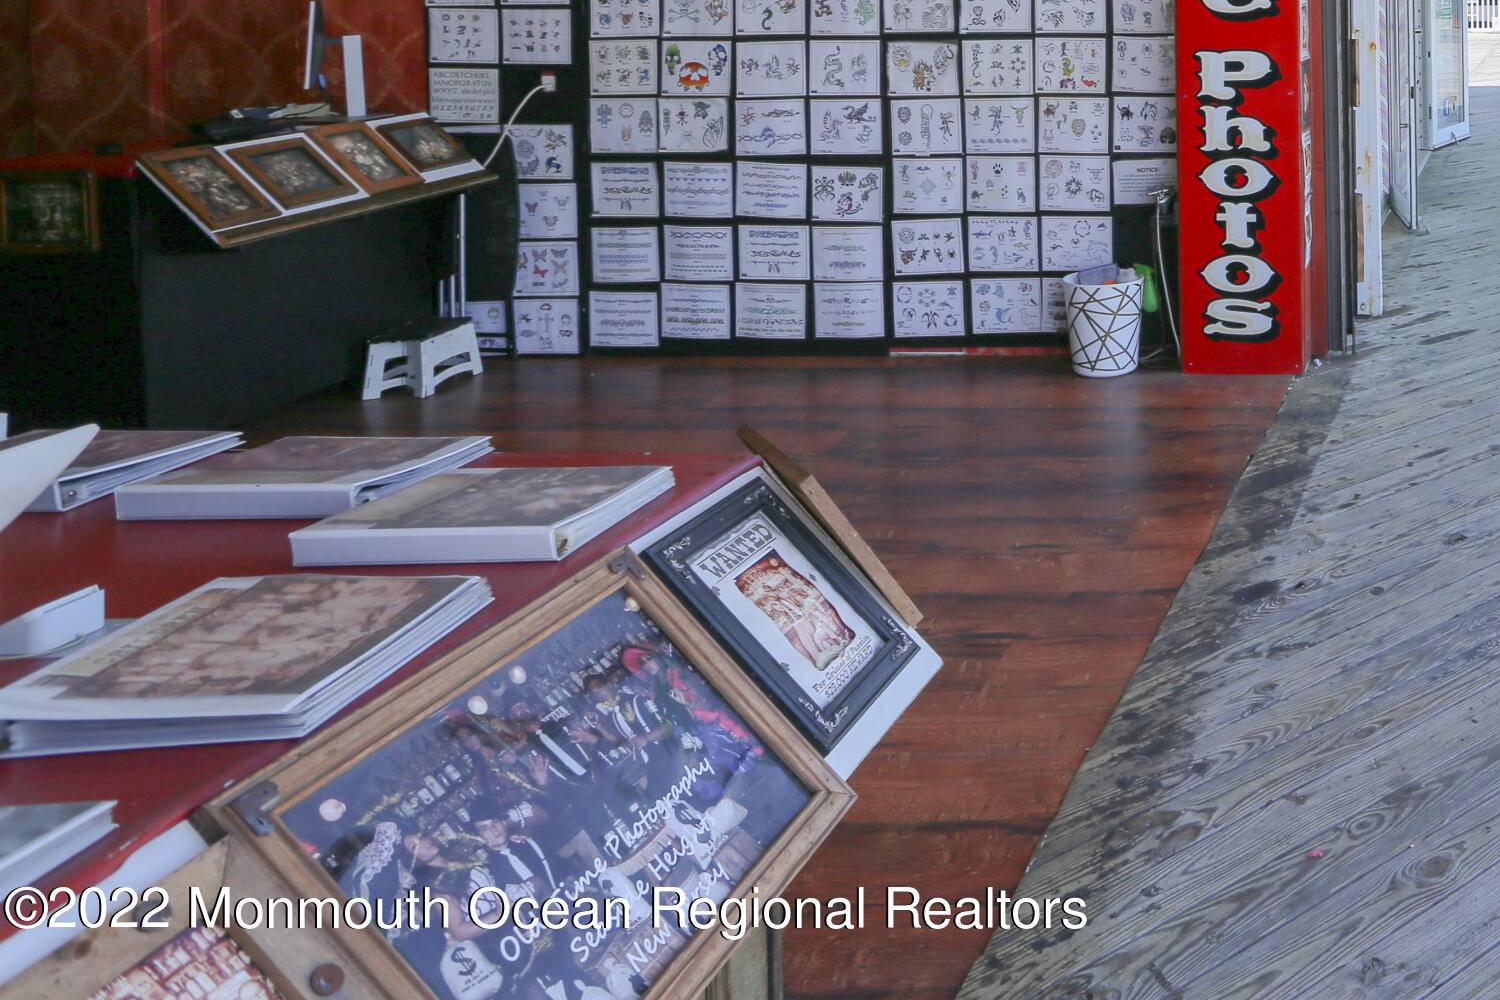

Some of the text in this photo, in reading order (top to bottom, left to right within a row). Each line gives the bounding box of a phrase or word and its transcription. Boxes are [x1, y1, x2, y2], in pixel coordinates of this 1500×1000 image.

[1194, 50, 1283, 342] Photos
[700, 523, 775, 580] WANTED
[604, 757, 716, 859] Photography
[626, 923, 672, 974] New
